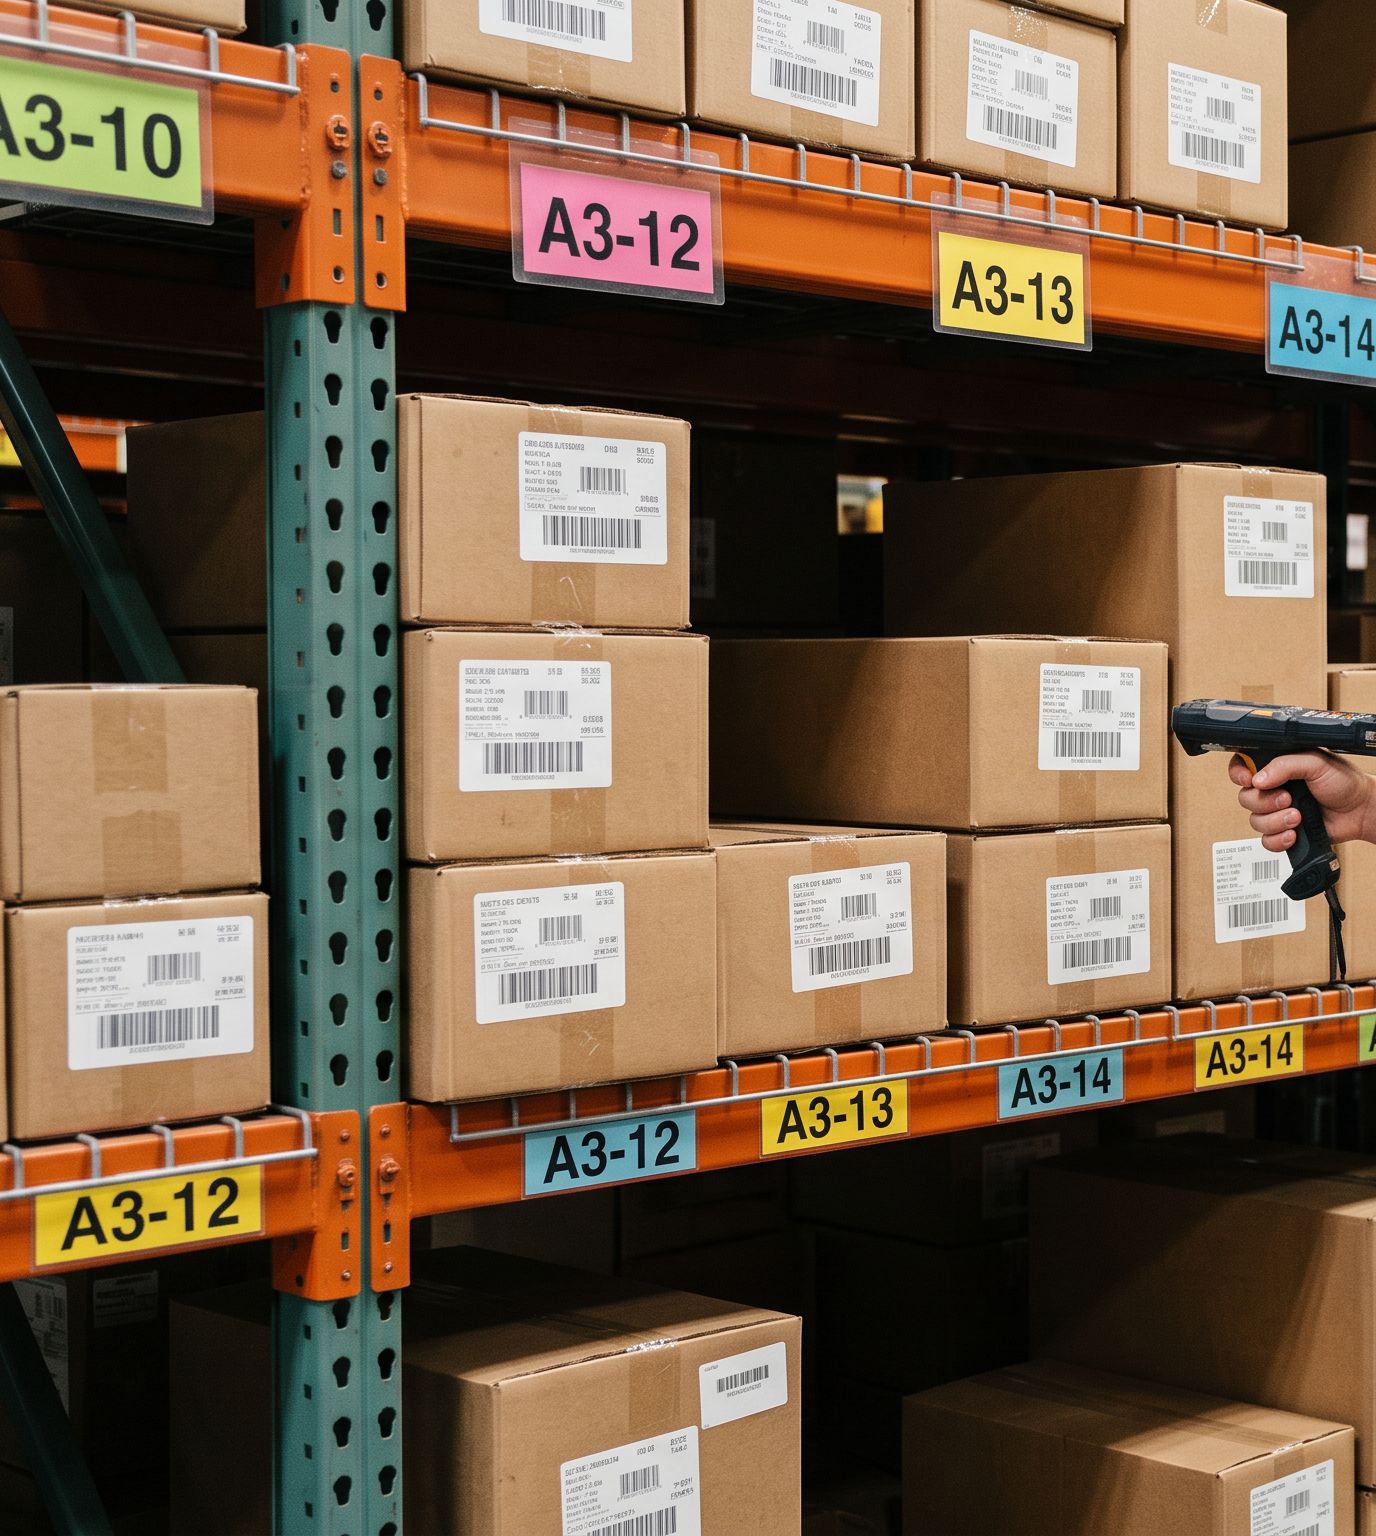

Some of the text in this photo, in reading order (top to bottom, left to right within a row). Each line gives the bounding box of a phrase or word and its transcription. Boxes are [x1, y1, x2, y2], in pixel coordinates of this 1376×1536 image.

[538, 196, 700, 272] A3-12
[951, 260, 1074, 325] A3-13
[1278, 305, 1376, 362] A3-14
[1010, 1056, 1112, 1109] A3-14
[1205, 1031, 1294, 1079] A3-14
[776, 1086, 894, 1144] A3-13
[543, 1119, 680, 1185] A3-12
[60, 1176, 240, 1252] A3-12
